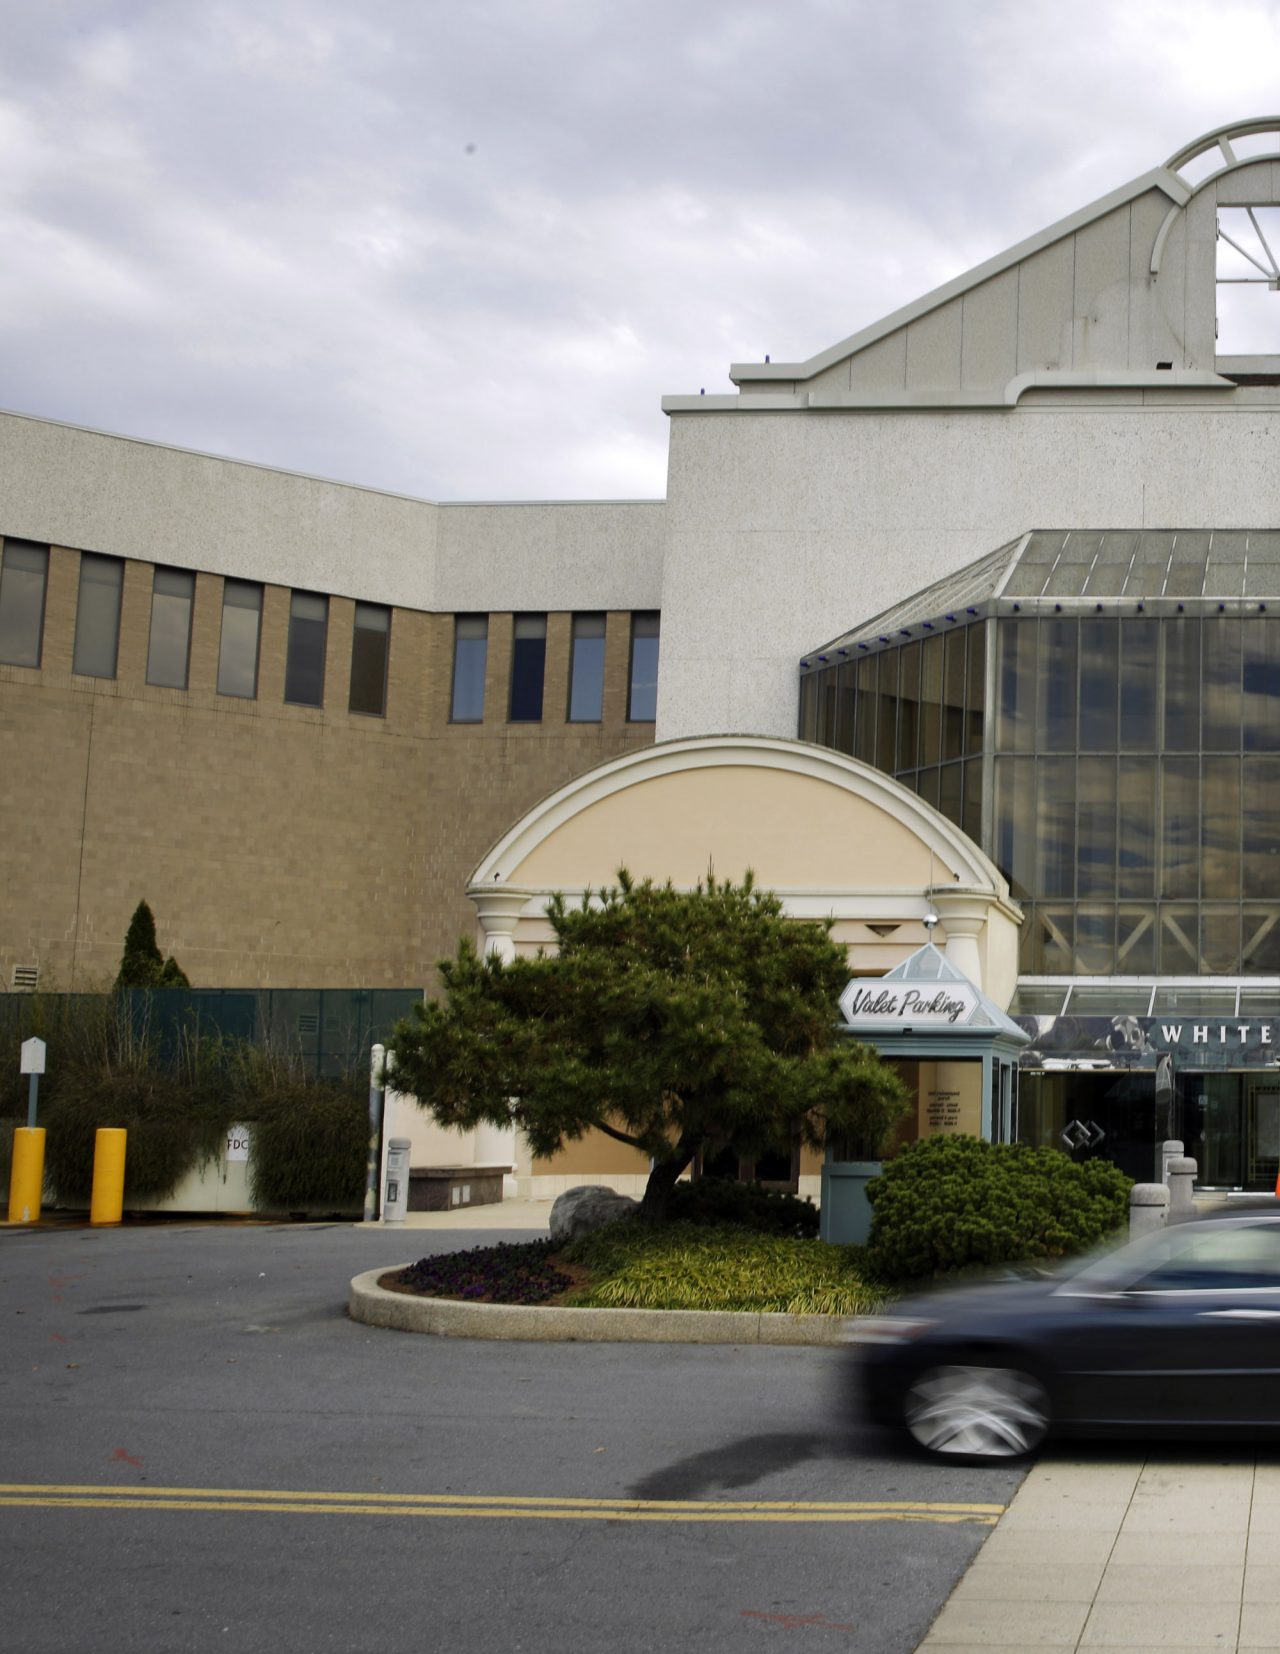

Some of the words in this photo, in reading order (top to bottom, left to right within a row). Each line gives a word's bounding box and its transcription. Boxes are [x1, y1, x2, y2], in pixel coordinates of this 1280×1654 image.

[852, 988, 898, 1016] Valet
[898, 990, 966, 1023] Parking
[1161, 1025, 1272, 1044] WHITE
[227, 1139, 249, 1151] FDC
